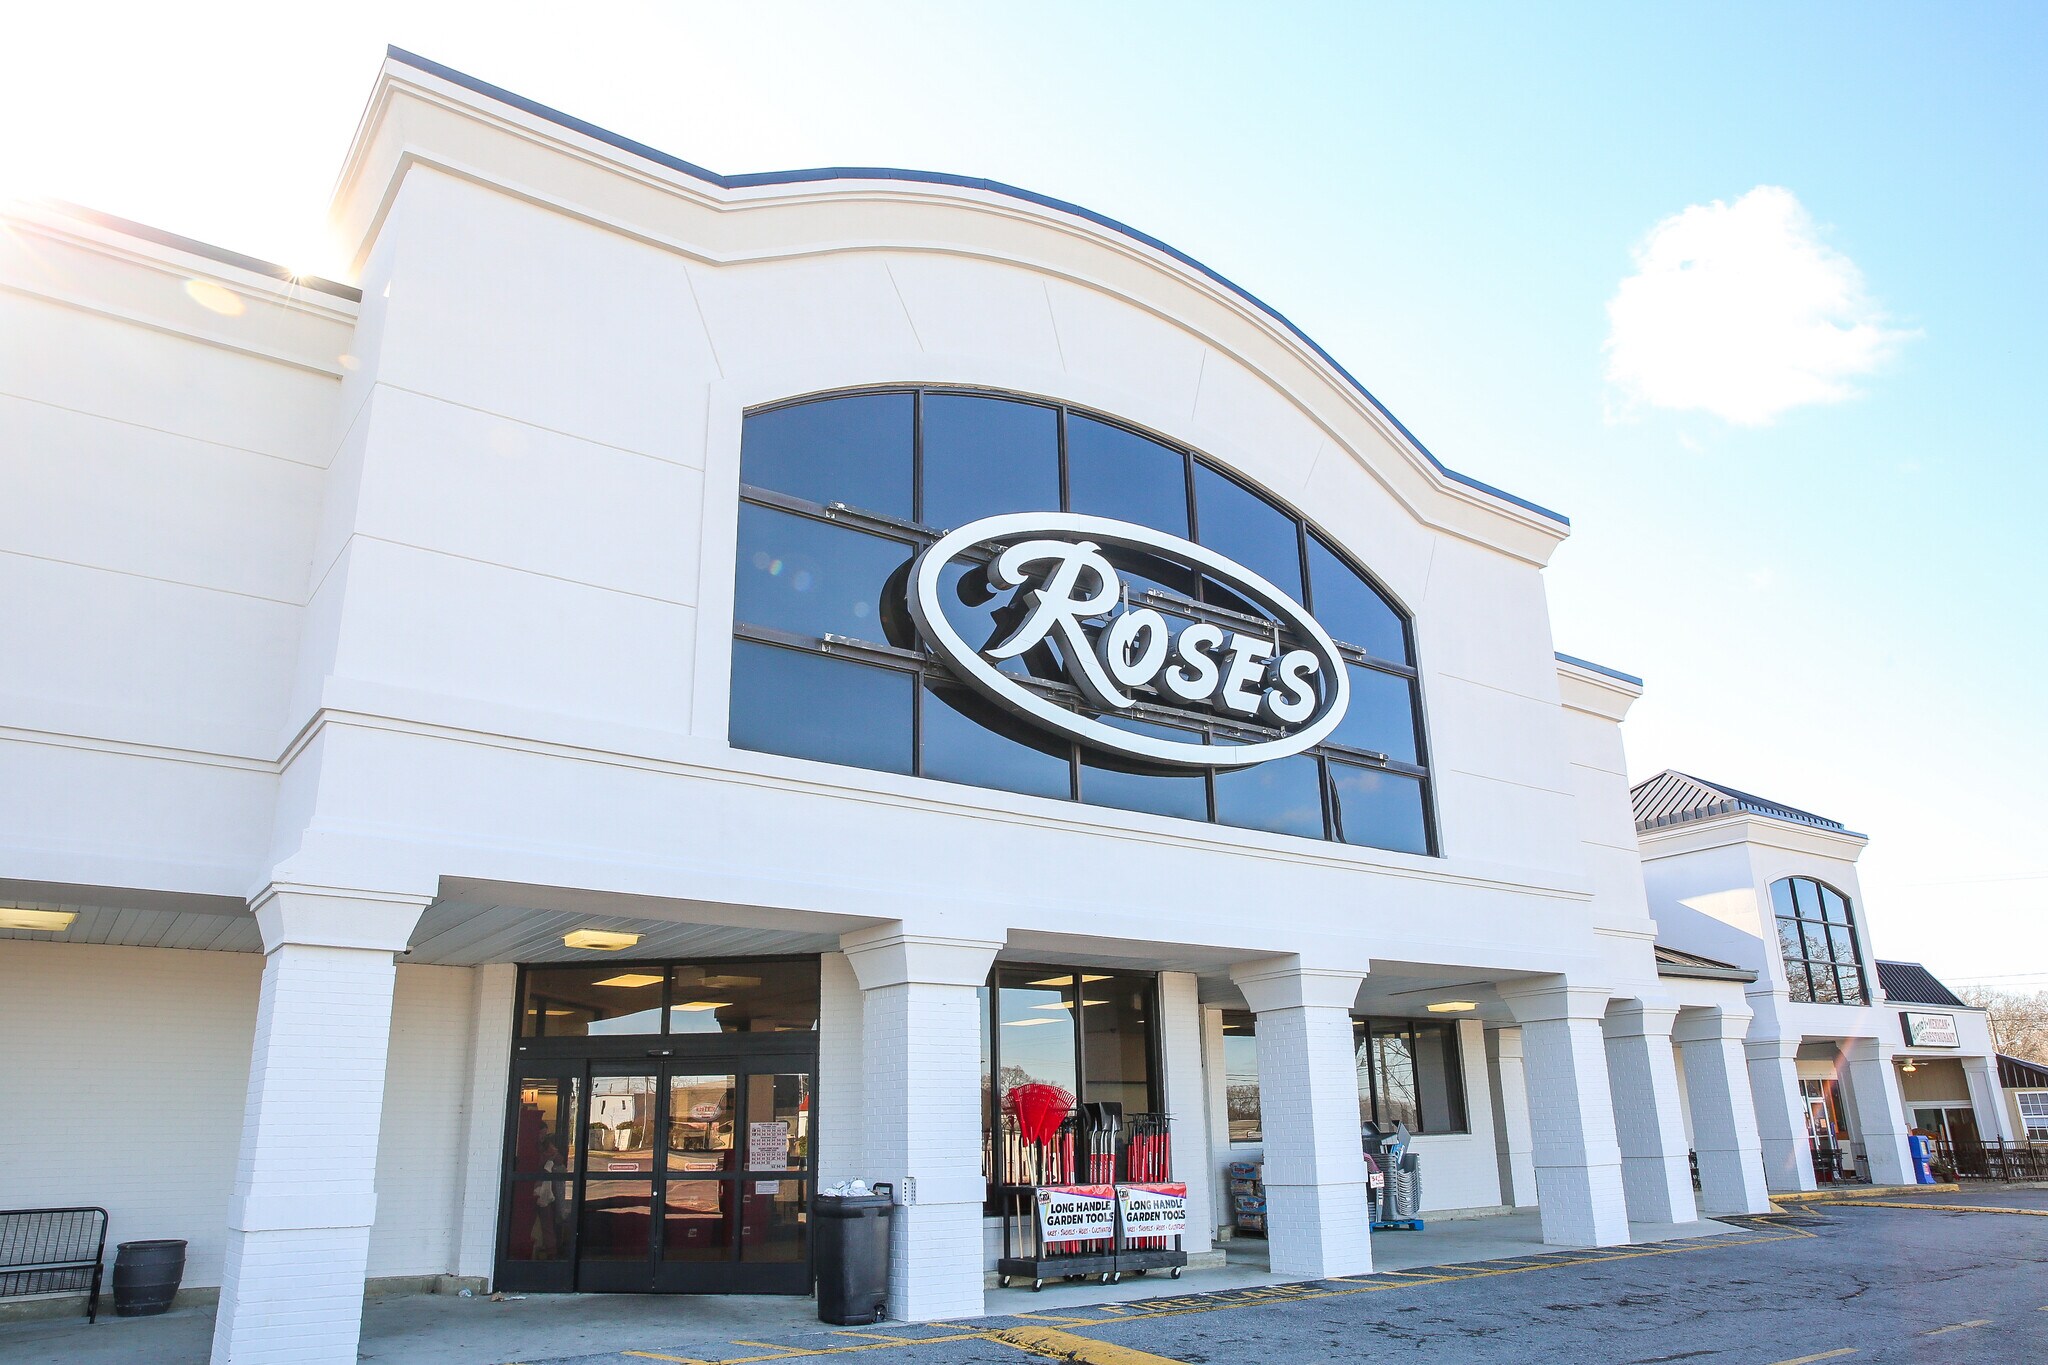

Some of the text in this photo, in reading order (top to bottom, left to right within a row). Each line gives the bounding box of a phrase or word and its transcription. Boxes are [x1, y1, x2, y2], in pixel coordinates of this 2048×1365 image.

[985, 540, 1319, 723] ROSES
[1050, 1201, 1111, 1214] LONG HANDLE
[1129, 1199, 1183, 1211] LONG HANDLE
[1047, 1211, 1114, 1226] GARDEN TOOLS
[1126, 1211, 1160, 1222] GARDEN
[1098, 1285, 1323, 1315] FIRE LANE
